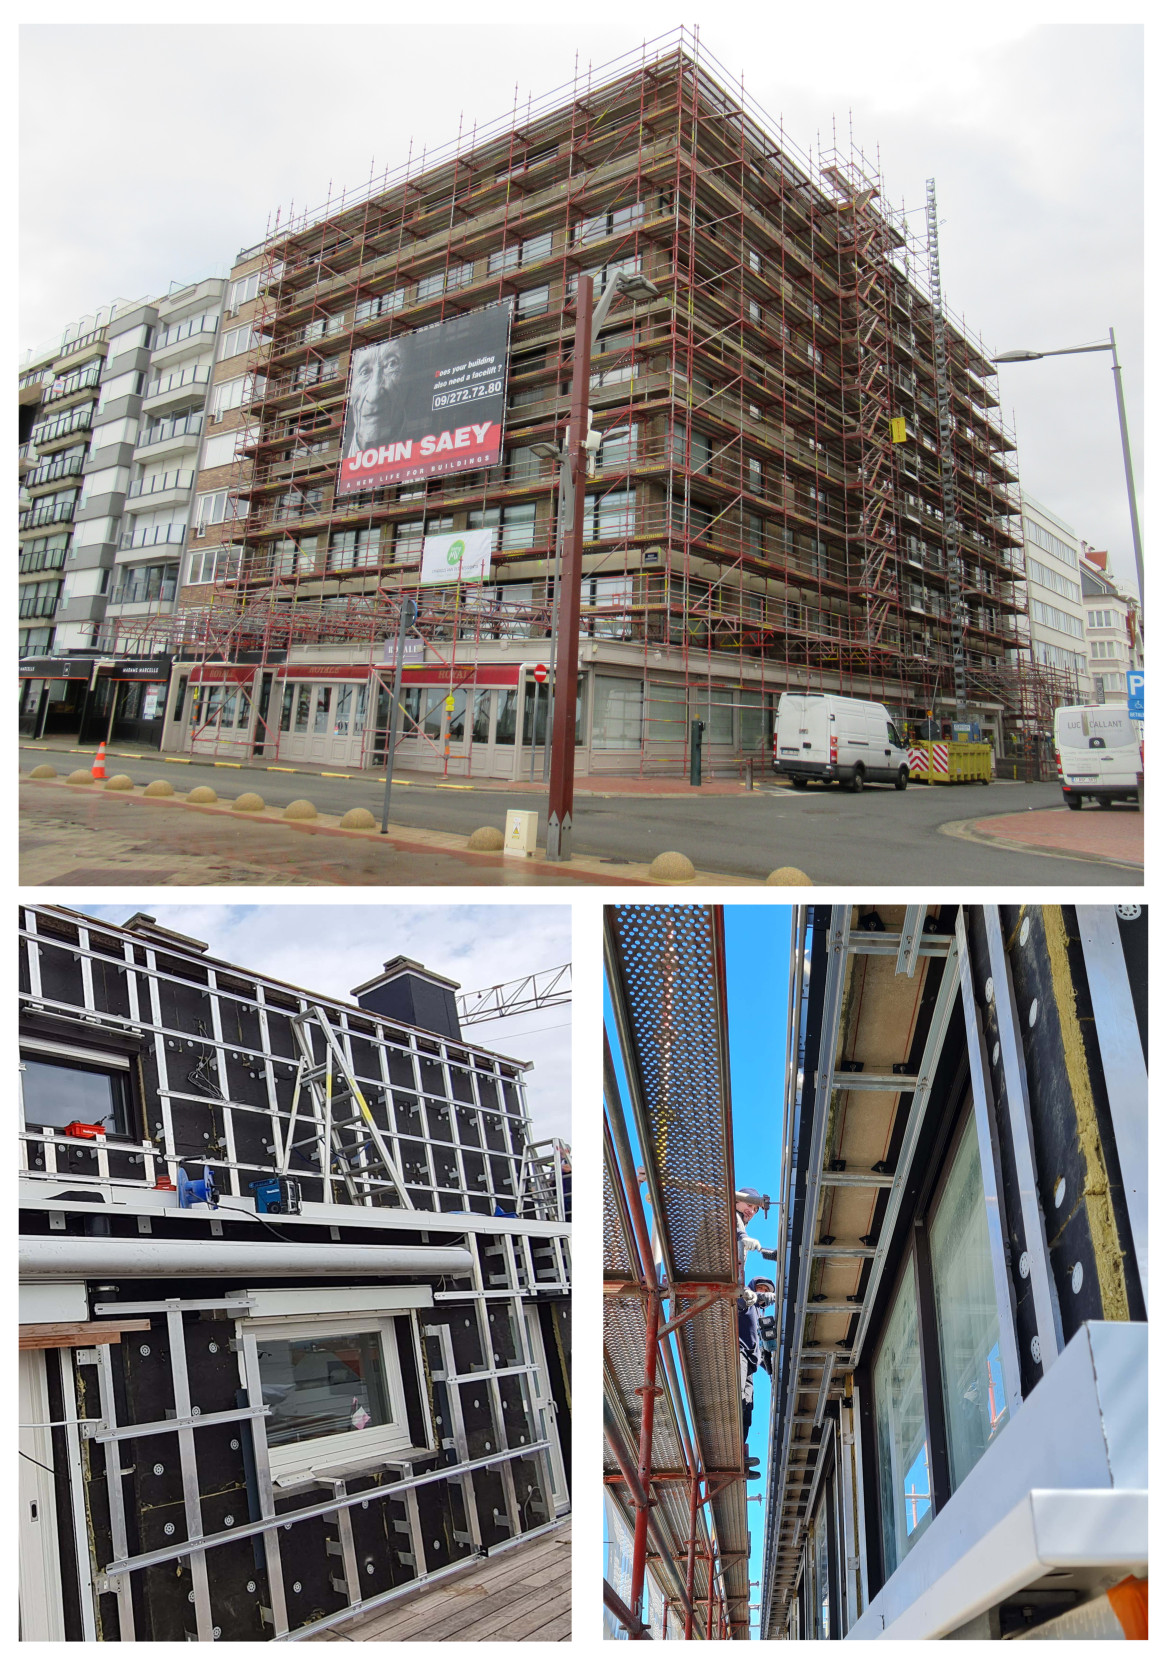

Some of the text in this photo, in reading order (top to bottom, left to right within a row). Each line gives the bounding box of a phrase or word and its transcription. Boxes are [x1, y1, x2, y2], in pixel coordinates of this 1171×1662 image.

[435, 355, 495, 378] Does your building
[433, 379, 447, 390] also
[448, 375, 465, 386] need
[471, 367, 497, 381] facelift
[434, 380, 502, 408] 09/272.72.80
[349, 422, 492, 471] JOHN SAEY
[346, 454, 490, 489] A NEW LIFE FOR BUILDINGS
[1129, 674, 1144, 696] P
[1067, 720, 1122, 729] LUC CALLANT
